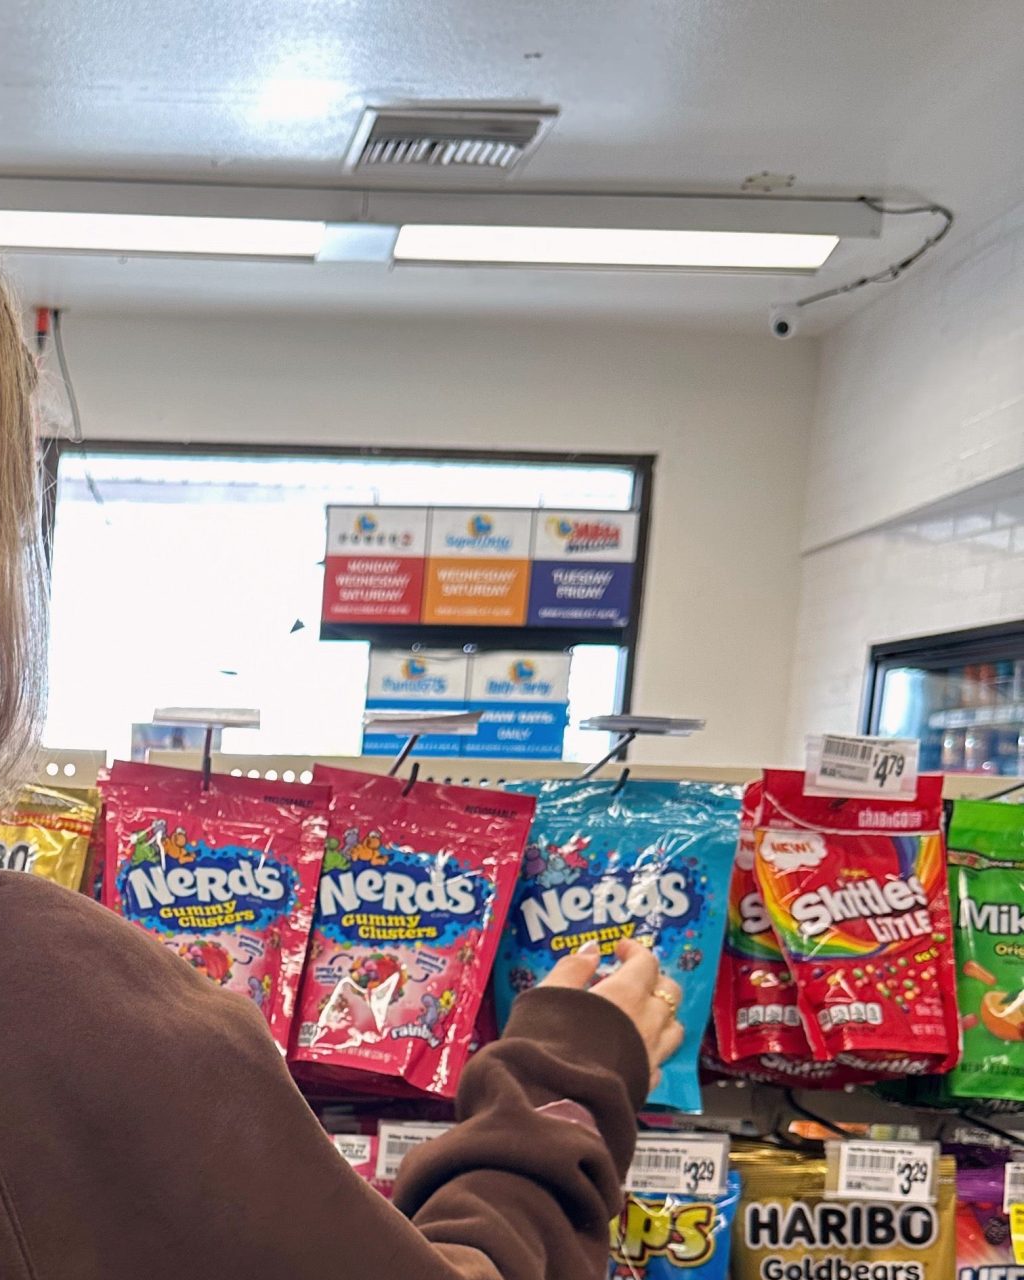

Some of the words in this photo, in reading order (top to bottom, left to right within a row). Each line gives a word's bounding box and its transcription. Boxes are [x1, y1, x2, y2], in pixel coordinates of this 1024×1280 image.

[160, 900, 237, 920] Gummy
[791, 874, 927, 936] Skittles
[960, 898, 1024, 934] Mik
[178, 909, 255, 929] Clusters
[342, 914, 422, 929] Gummy
[358, 925, 437, 940] Clusters
[551, 922, 637, 950] Gummy
[748, 1204, 935, 1247] HARIBO
